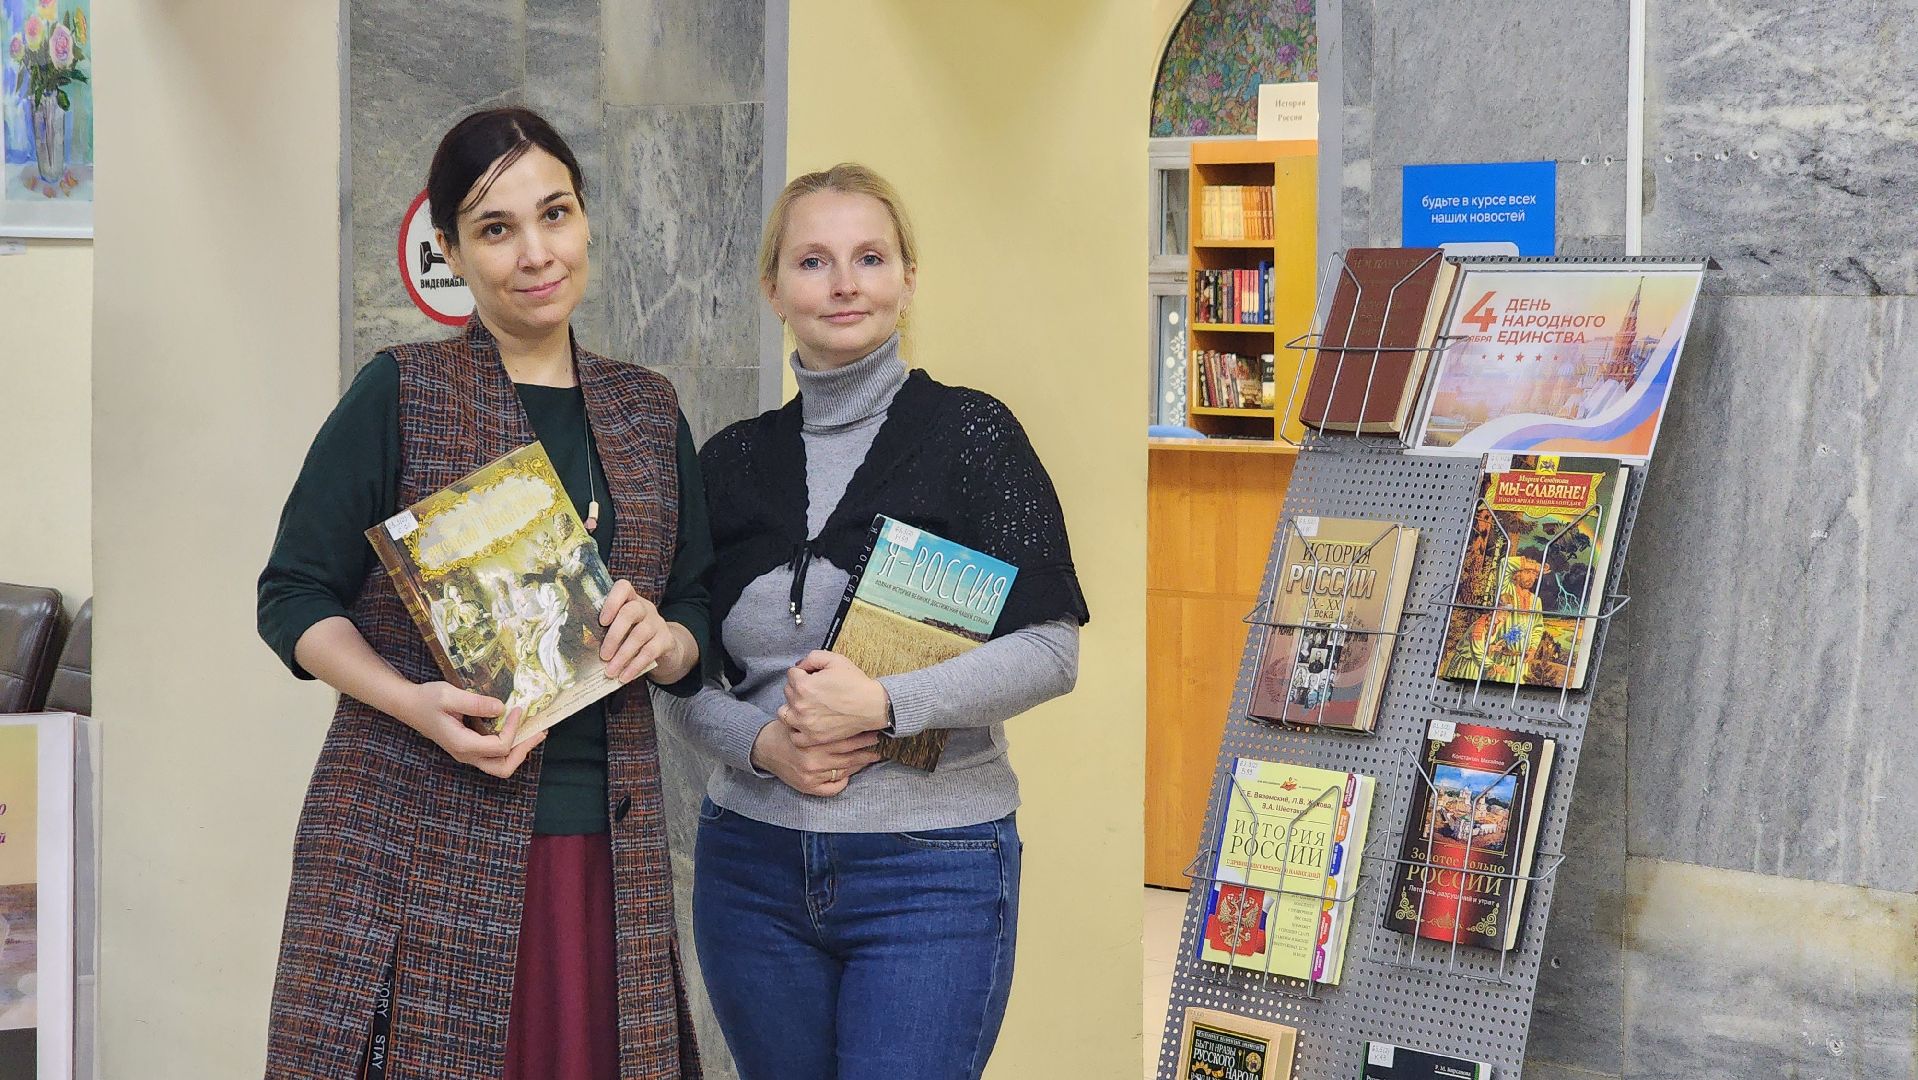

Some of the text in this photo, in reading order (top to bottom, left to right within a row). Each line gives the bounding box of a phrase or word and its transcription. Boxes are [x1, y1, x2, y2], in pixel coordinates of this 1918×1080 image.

[1422, 194, 1537, 210] будьте в курсе всех
[1431, 209, 1526, 224] наших новостей
[1461, 291, 1498, 332] 4
[1505, 299, 1551, 313] ДЕНЬ
[1502, 315, 1606, 328] НАРОДНОГО
[1497, 331, 1585, 345] ЕДИНСТВА
[1303, 542, 1372, 564] ИСТОРИЯ
[1286, 564, 1377, 599] РОССИИ
[1314, 609, 1334, 619] века
[1306, 798, 1334, 809] Жкова,
[1234, 819, 1326, 847] ИСТОРИЯ
[1230, 835, 1324, 868] РОССИИ
[1465, 859, 1505, 874] ольцо
[1407, 884, 1436, 896] Летоись
[371, 1034, 386, 1070] STAY
[1193, 1048, 1235, 1068] РУССКОГО
